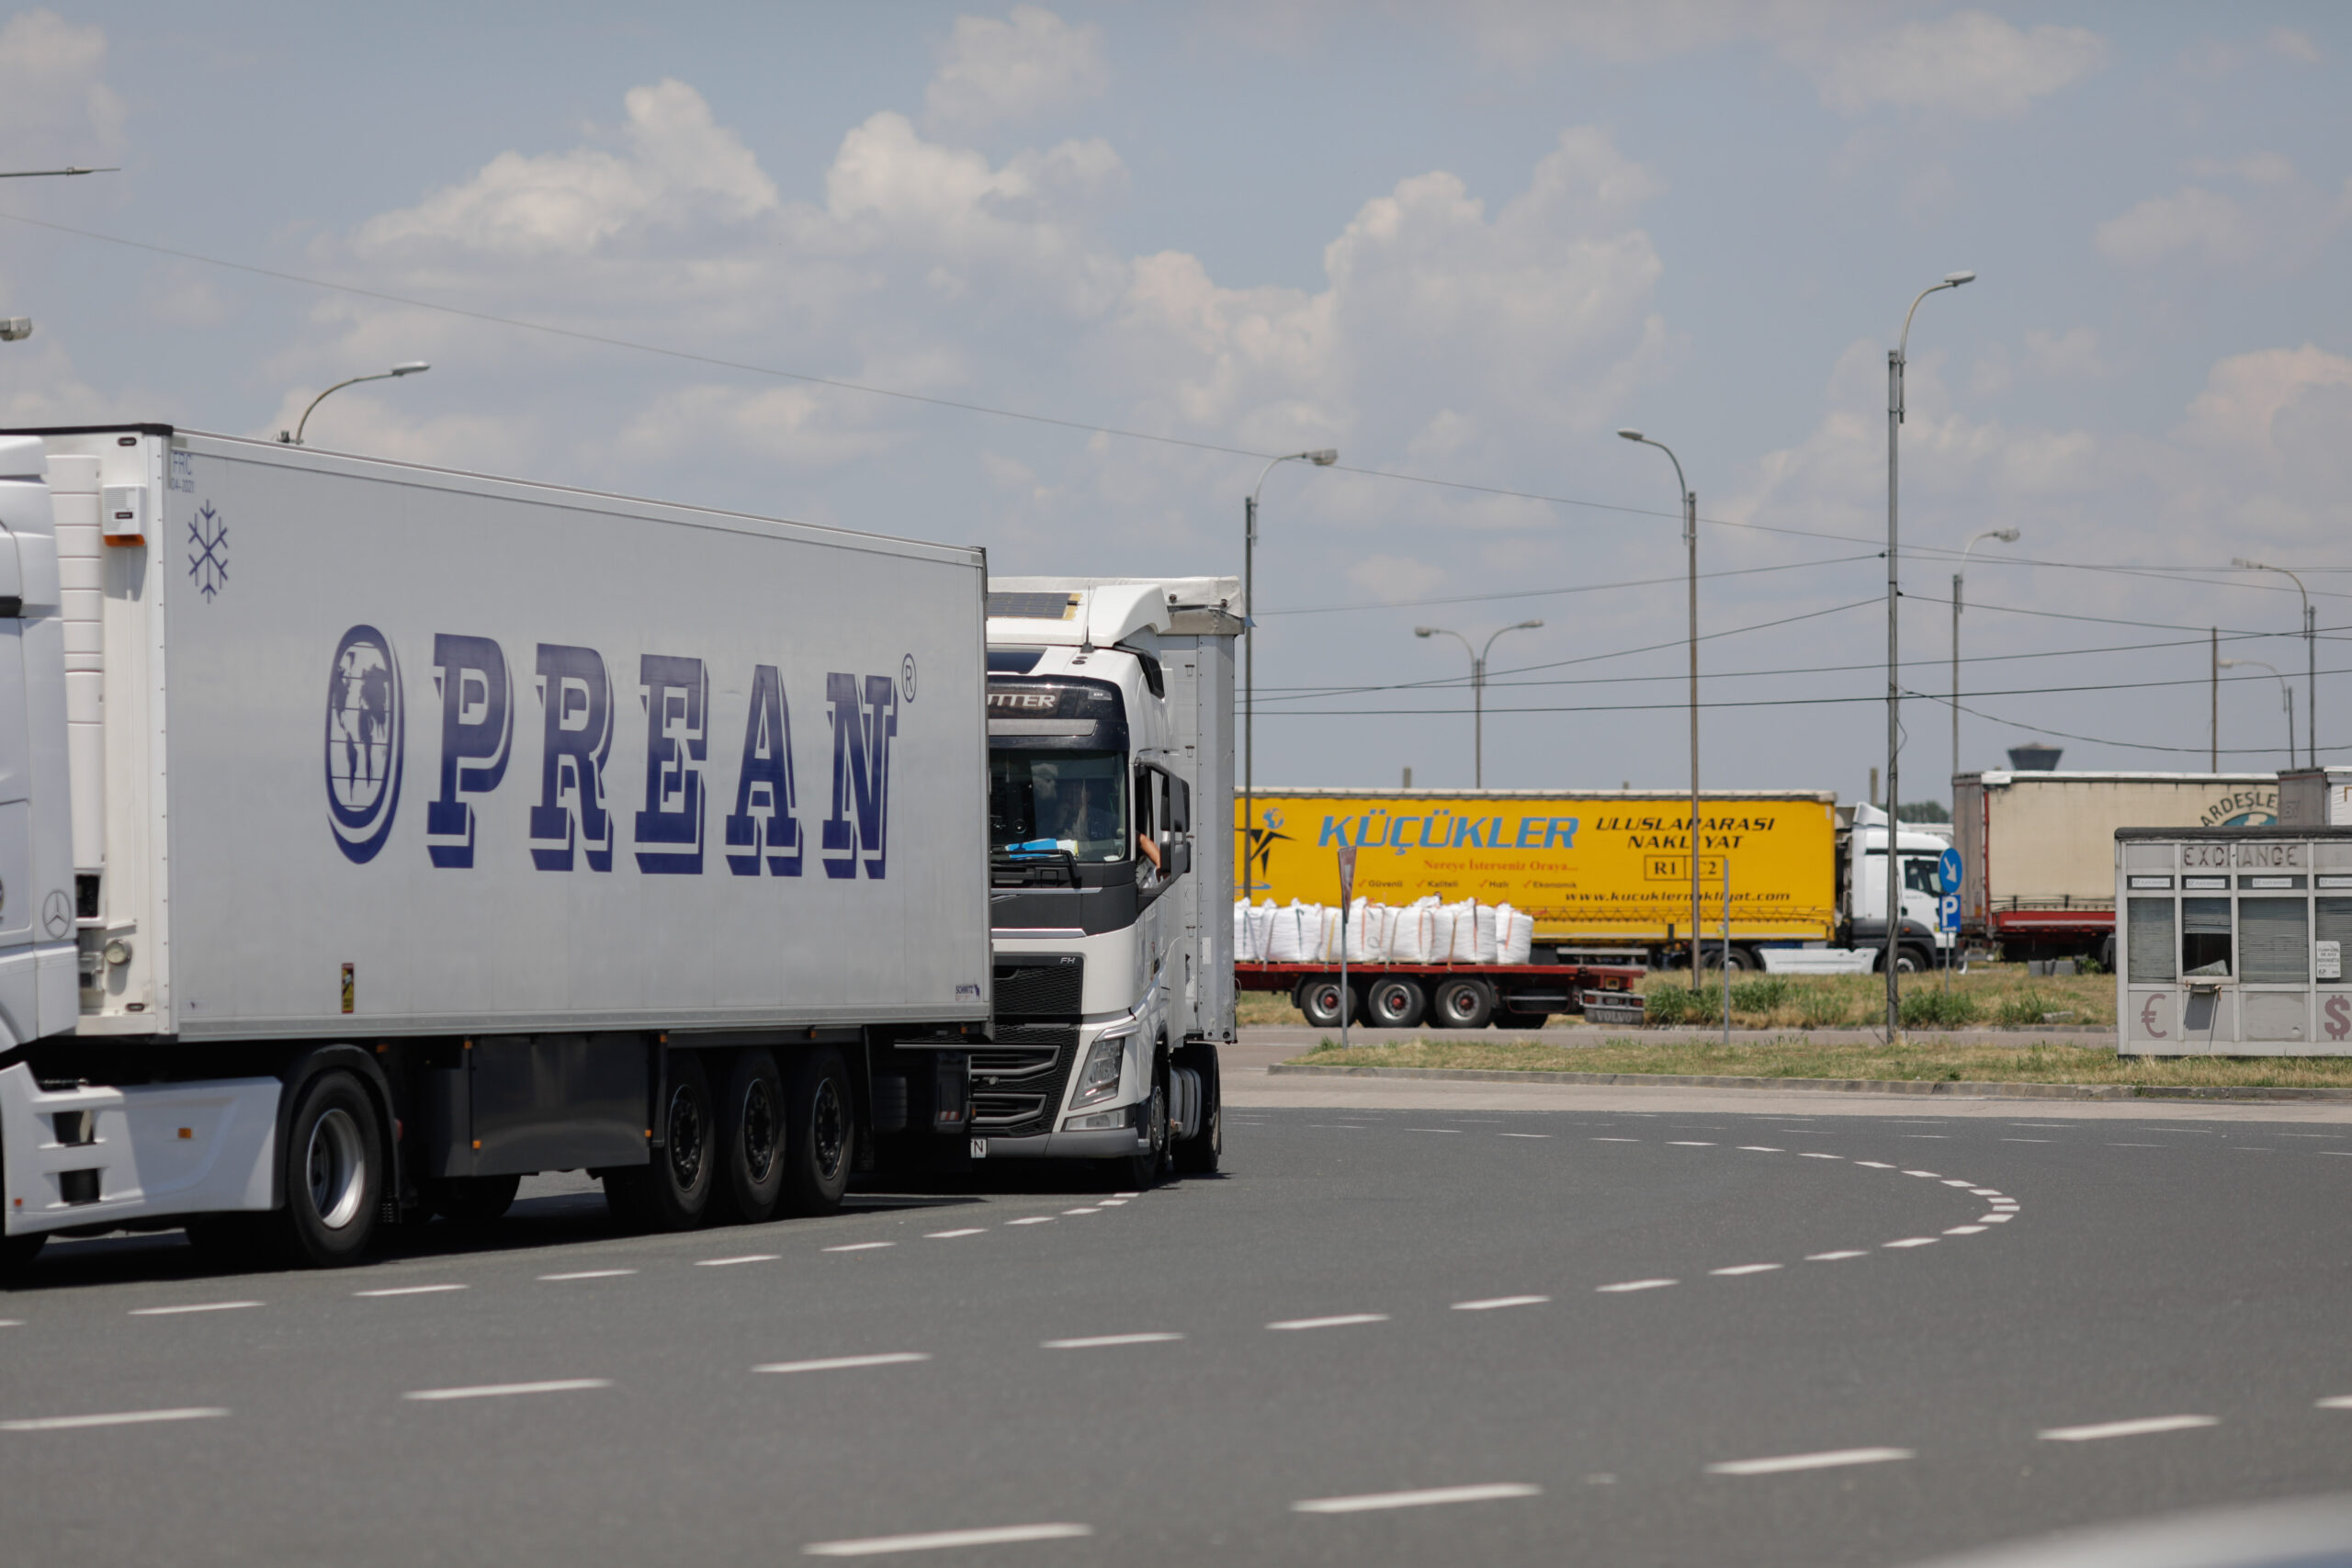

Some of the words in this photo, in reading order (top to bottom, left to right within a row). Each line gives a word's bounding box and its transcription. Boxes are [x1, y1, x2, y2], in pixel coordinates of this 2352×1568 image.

[325, 625, 899, 880] OPREAN
[1317, 808, 1580, 856] KÜÇÜKLER
[1627, 835, 1744, 850] NAKLYAT
[2184, 846, 2298, 866] EXCHANGE
[1654, 861, 1677, 875] R1
[1941, 897, 1959, 927] P
[1596, 1010, 1633, 1022] VOLVO
